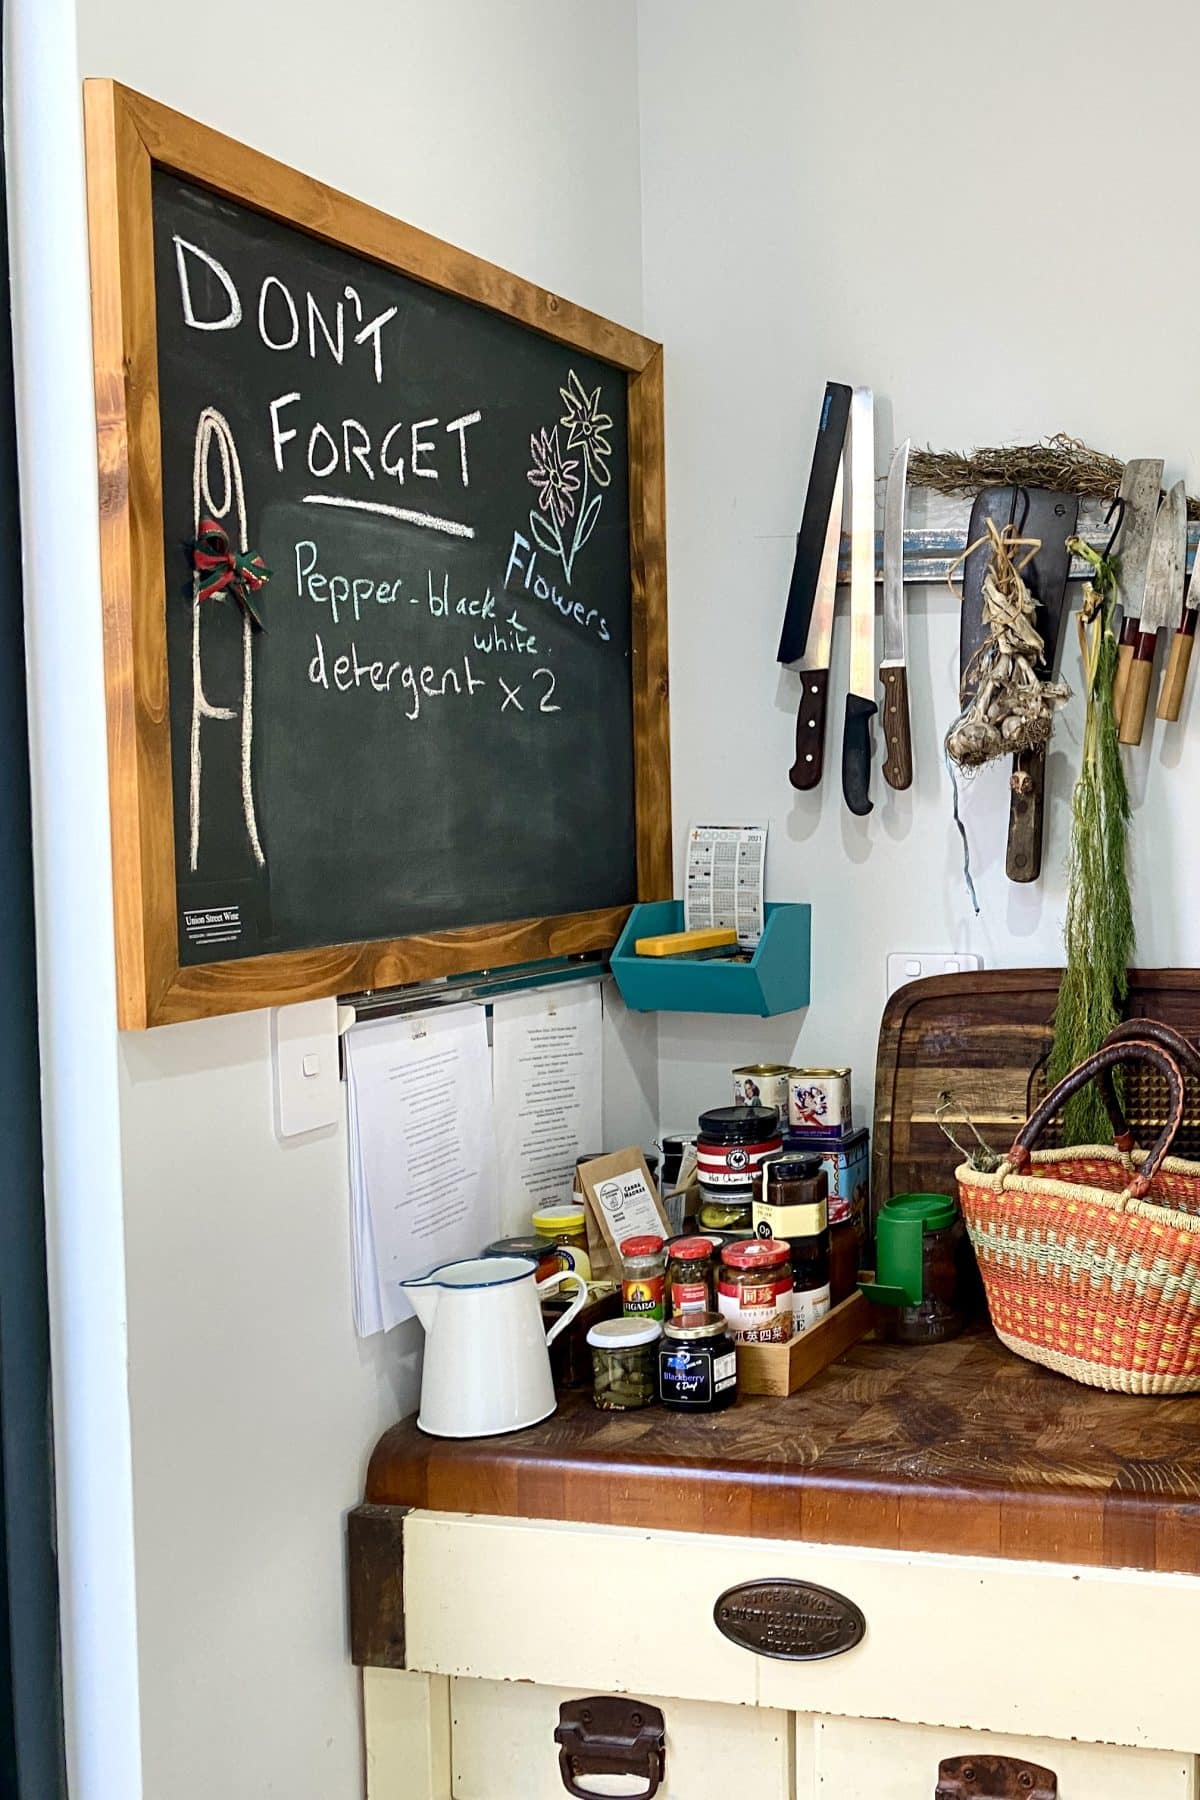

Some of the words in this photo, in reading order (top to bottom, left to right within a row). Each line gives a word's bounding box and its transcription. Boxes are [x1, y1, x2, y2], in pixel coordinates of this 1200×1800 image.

[172, 233, 399, 384] DON'T
[268, 391, 483, 489] FORGET
[294, 540, 402, 624] Pepper
[427, 567, 497, 620] black
[503, 530, 611, 641] Flowers
[308, 633, 486, 721] detergent
[185, 914, 205, 926] Union
[205, 913, 223, 924] Street
[663, 1371, 705, 1384] Blackberry
